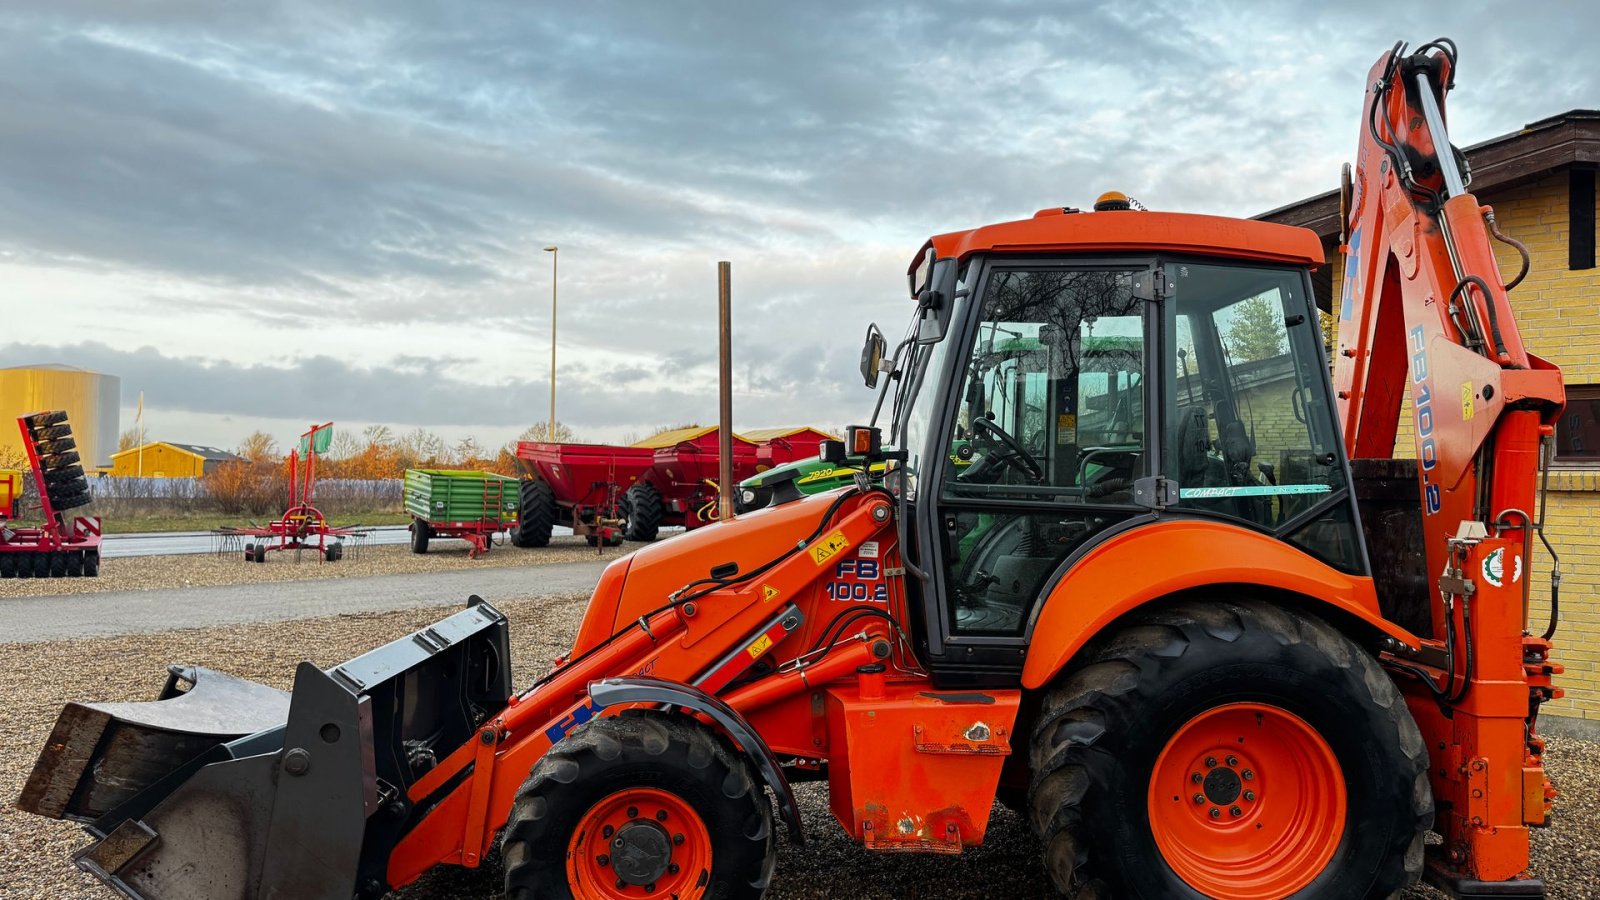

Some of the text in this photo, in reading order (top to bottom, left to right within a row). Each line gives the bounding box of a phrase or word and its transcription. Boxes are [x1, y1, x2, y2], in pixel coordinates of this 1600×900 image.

[808, 468, 833, 480] 7920
[1184, 487, 1241, 498] COMPACT
[836, 560, 879, 580] FB
[826, 581, 888, 602] 100.2
